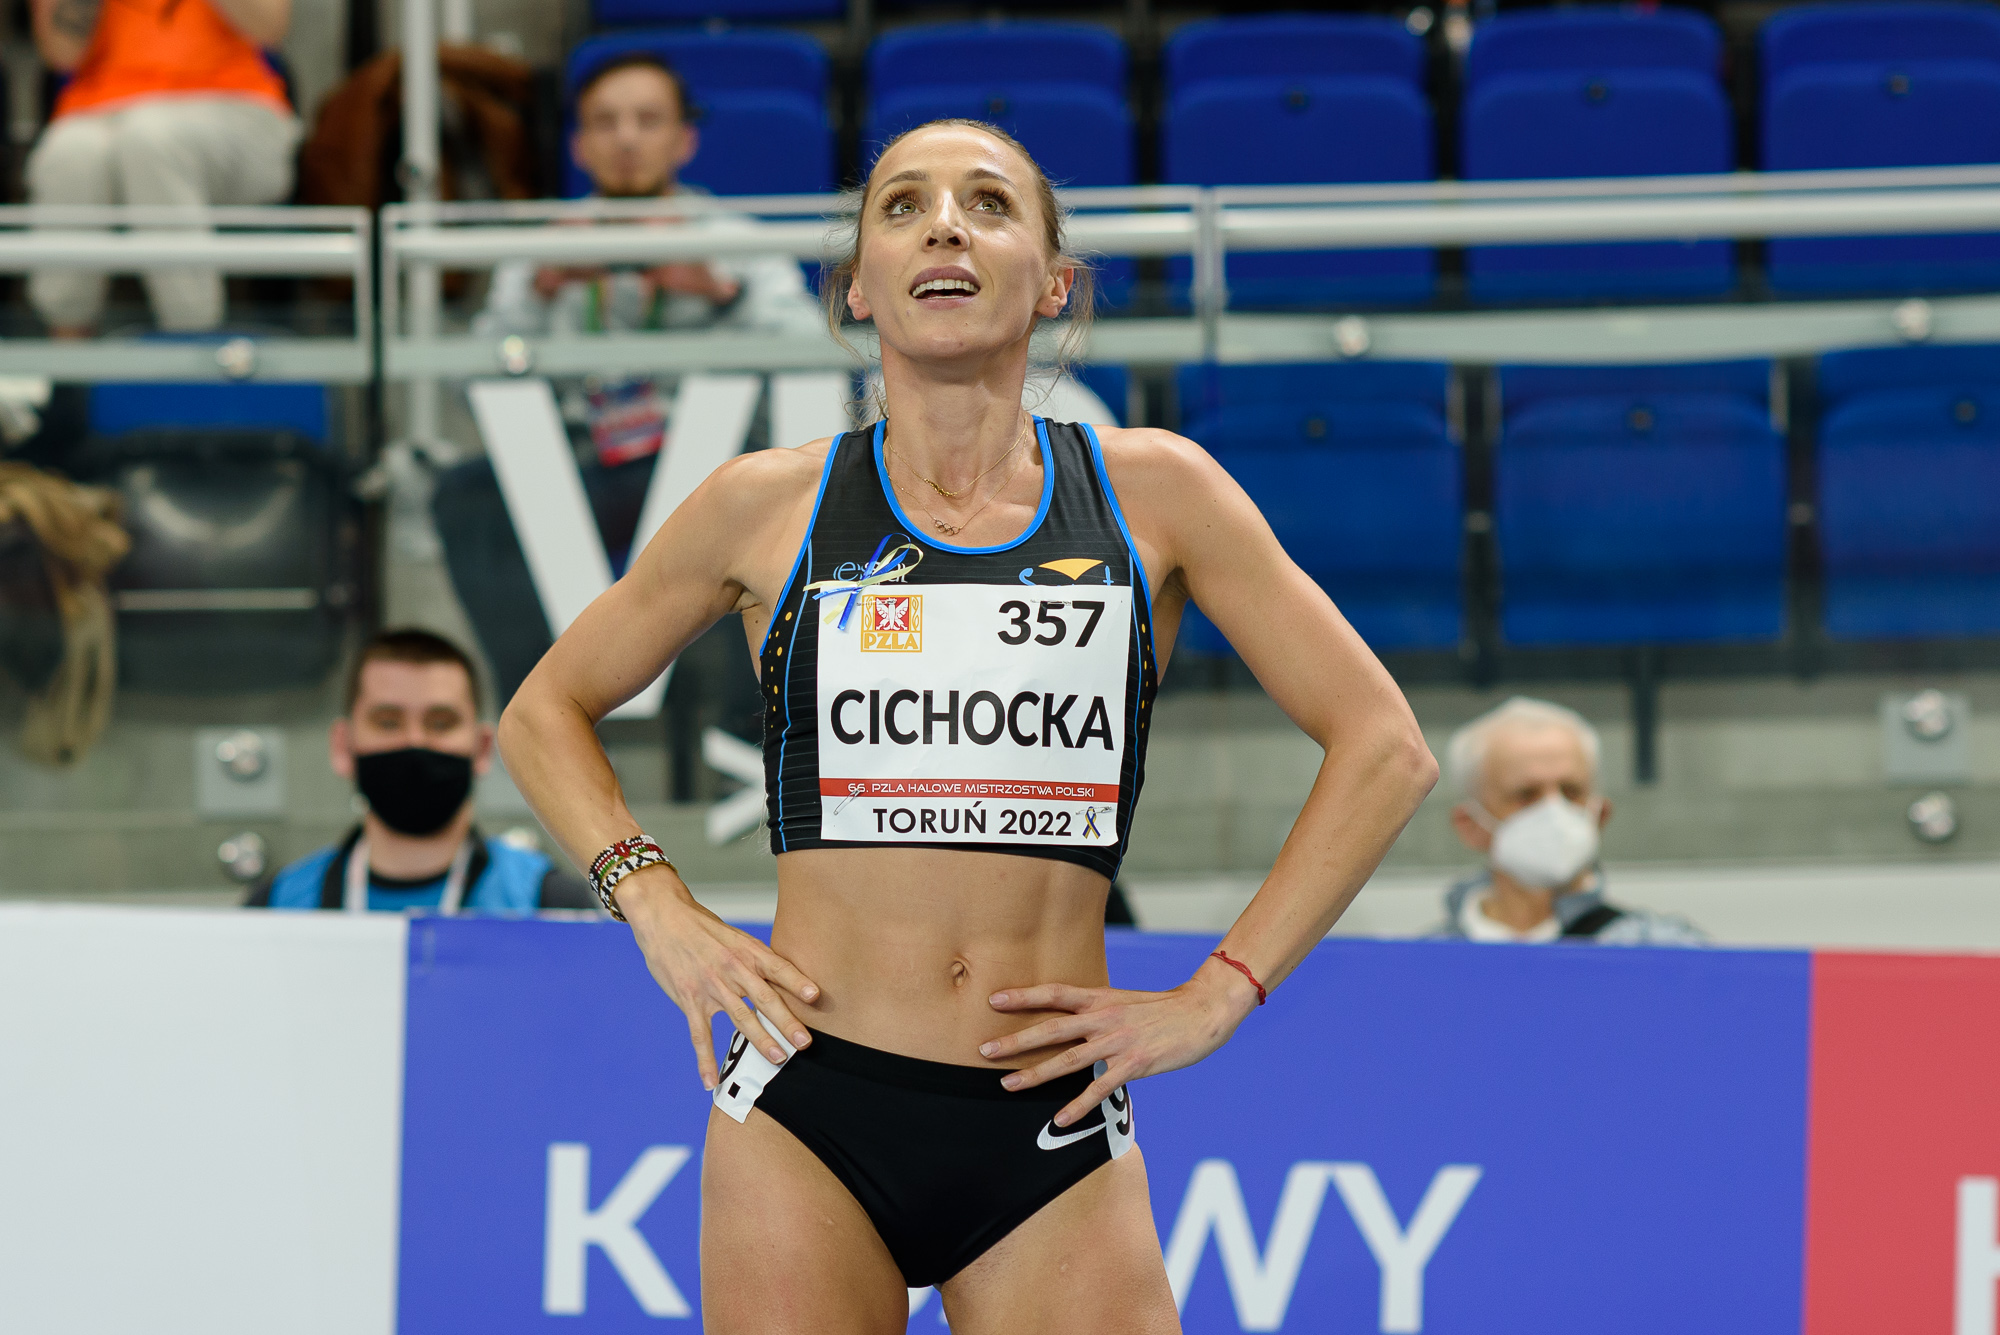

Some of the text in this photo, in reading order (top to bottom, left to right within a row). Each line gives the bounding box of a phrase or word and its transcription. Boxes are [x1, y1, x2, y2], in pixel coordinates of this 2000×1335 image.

[863, 632, 919, 650] PZLA
[997, 600, 1106, 648] 357
[830, 688, 1115, 752] CICHOCKA
[847, 783, 1095, 798] 66. PZLA HALOWE MISTRZOSTWA POLSKI
[872, 801, 1072, 836] TORUŃ 2022
